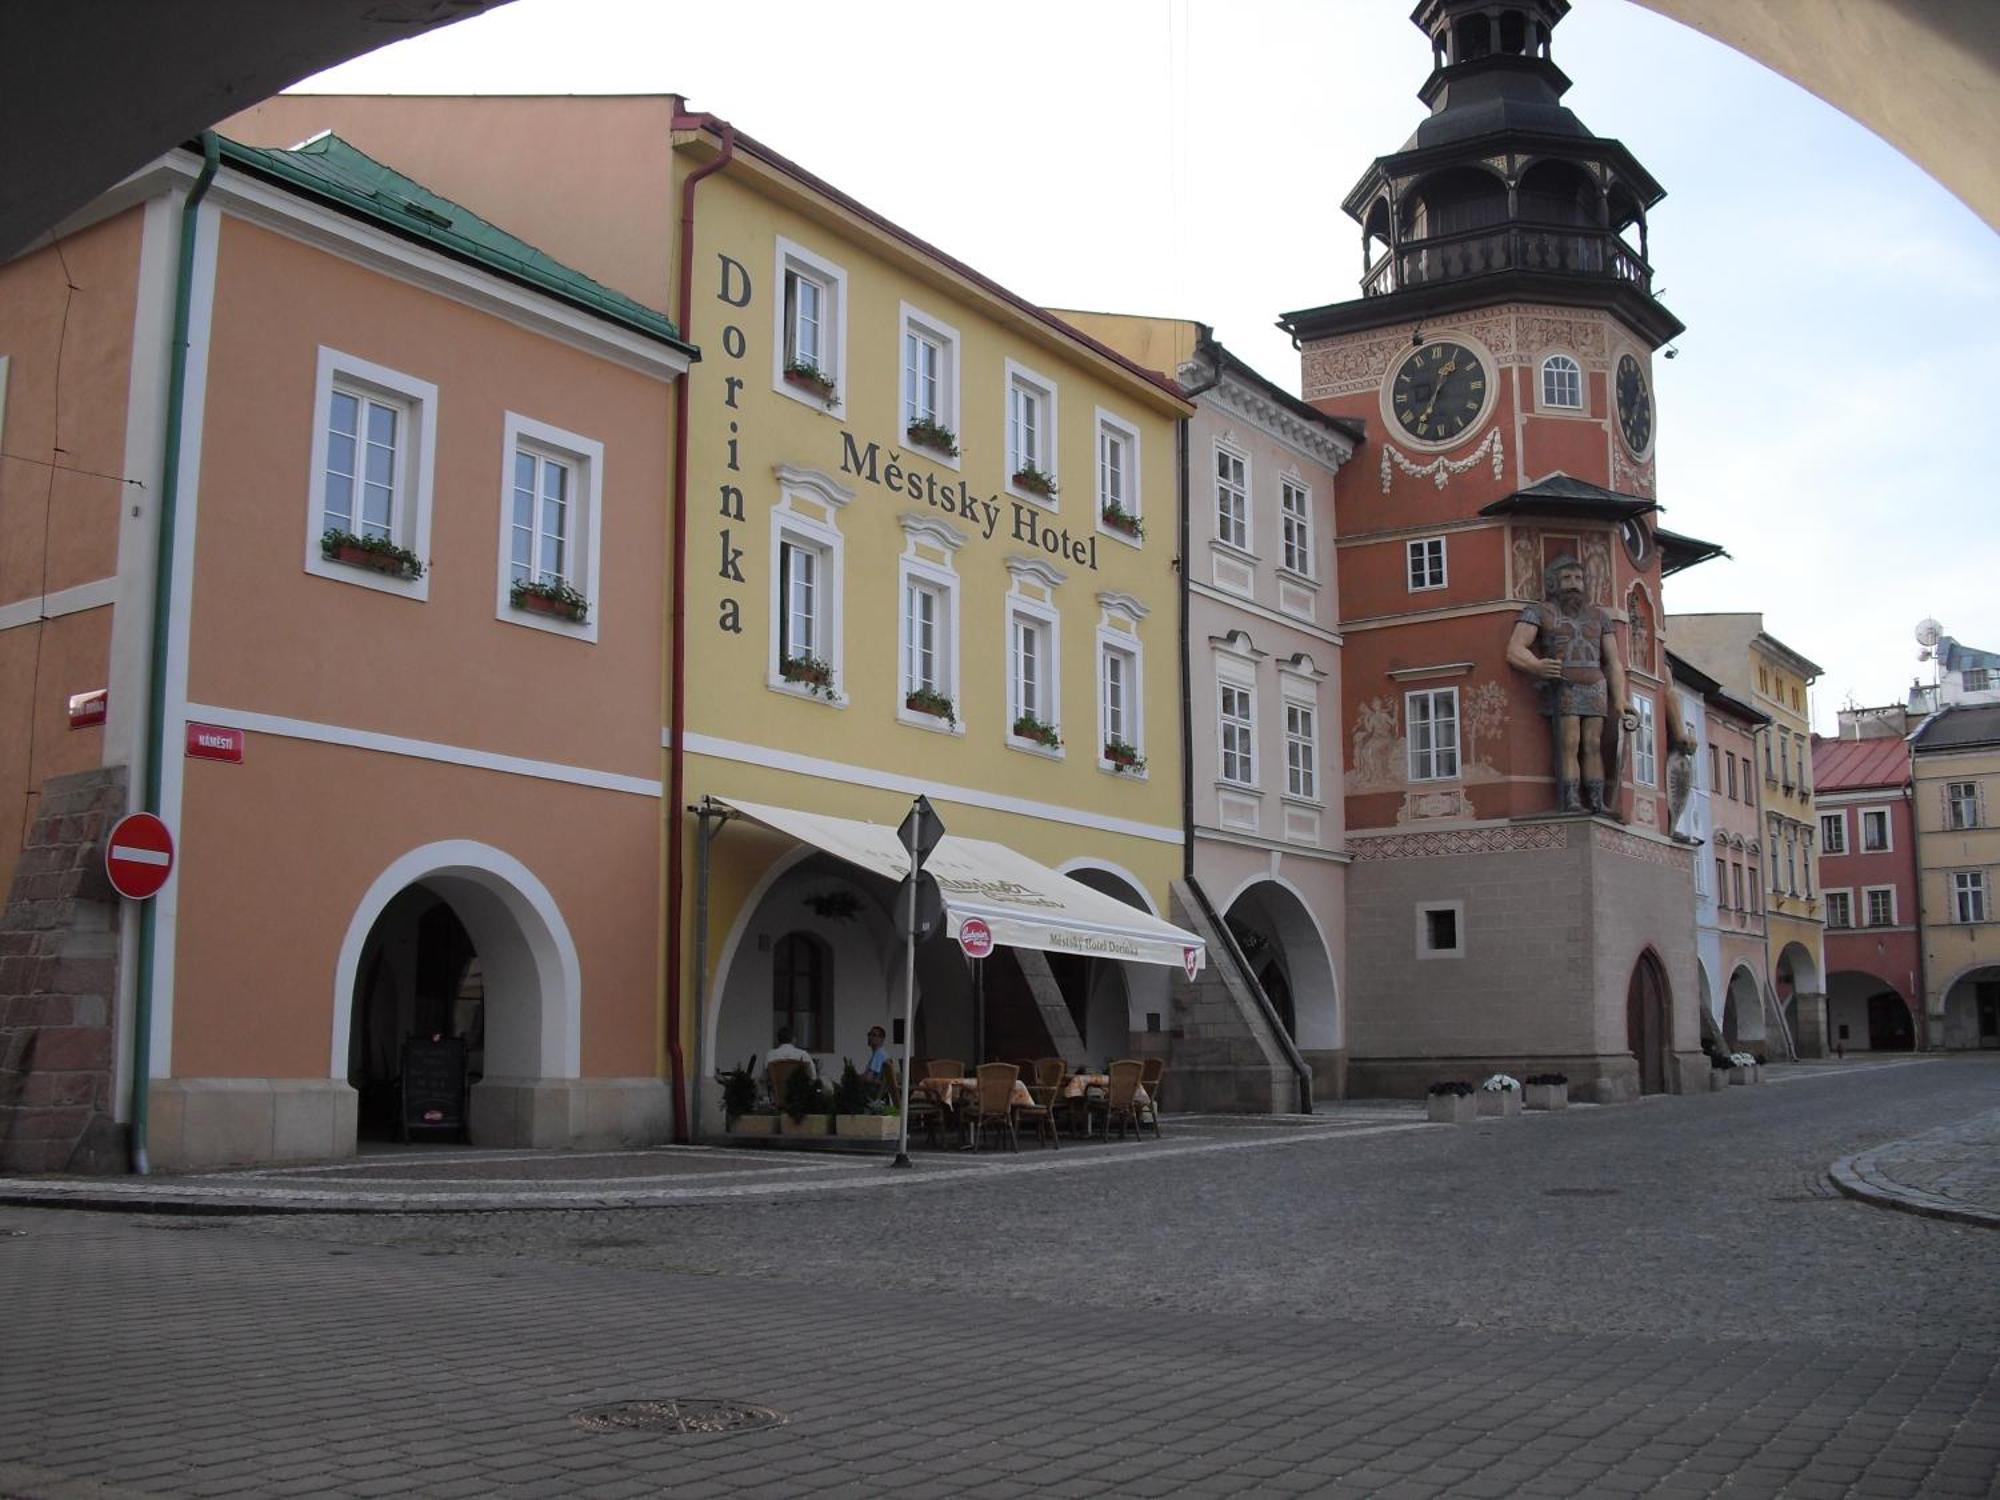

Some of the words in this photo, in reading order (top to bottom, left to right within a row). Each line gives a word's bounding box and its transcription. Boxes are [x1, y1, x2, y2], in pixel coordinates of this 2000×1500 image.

[716, 253, 753, 635] Dorinka
[840, 430, 1001, 540] Městský
[1010, 501, 1099, 571] Hotel
